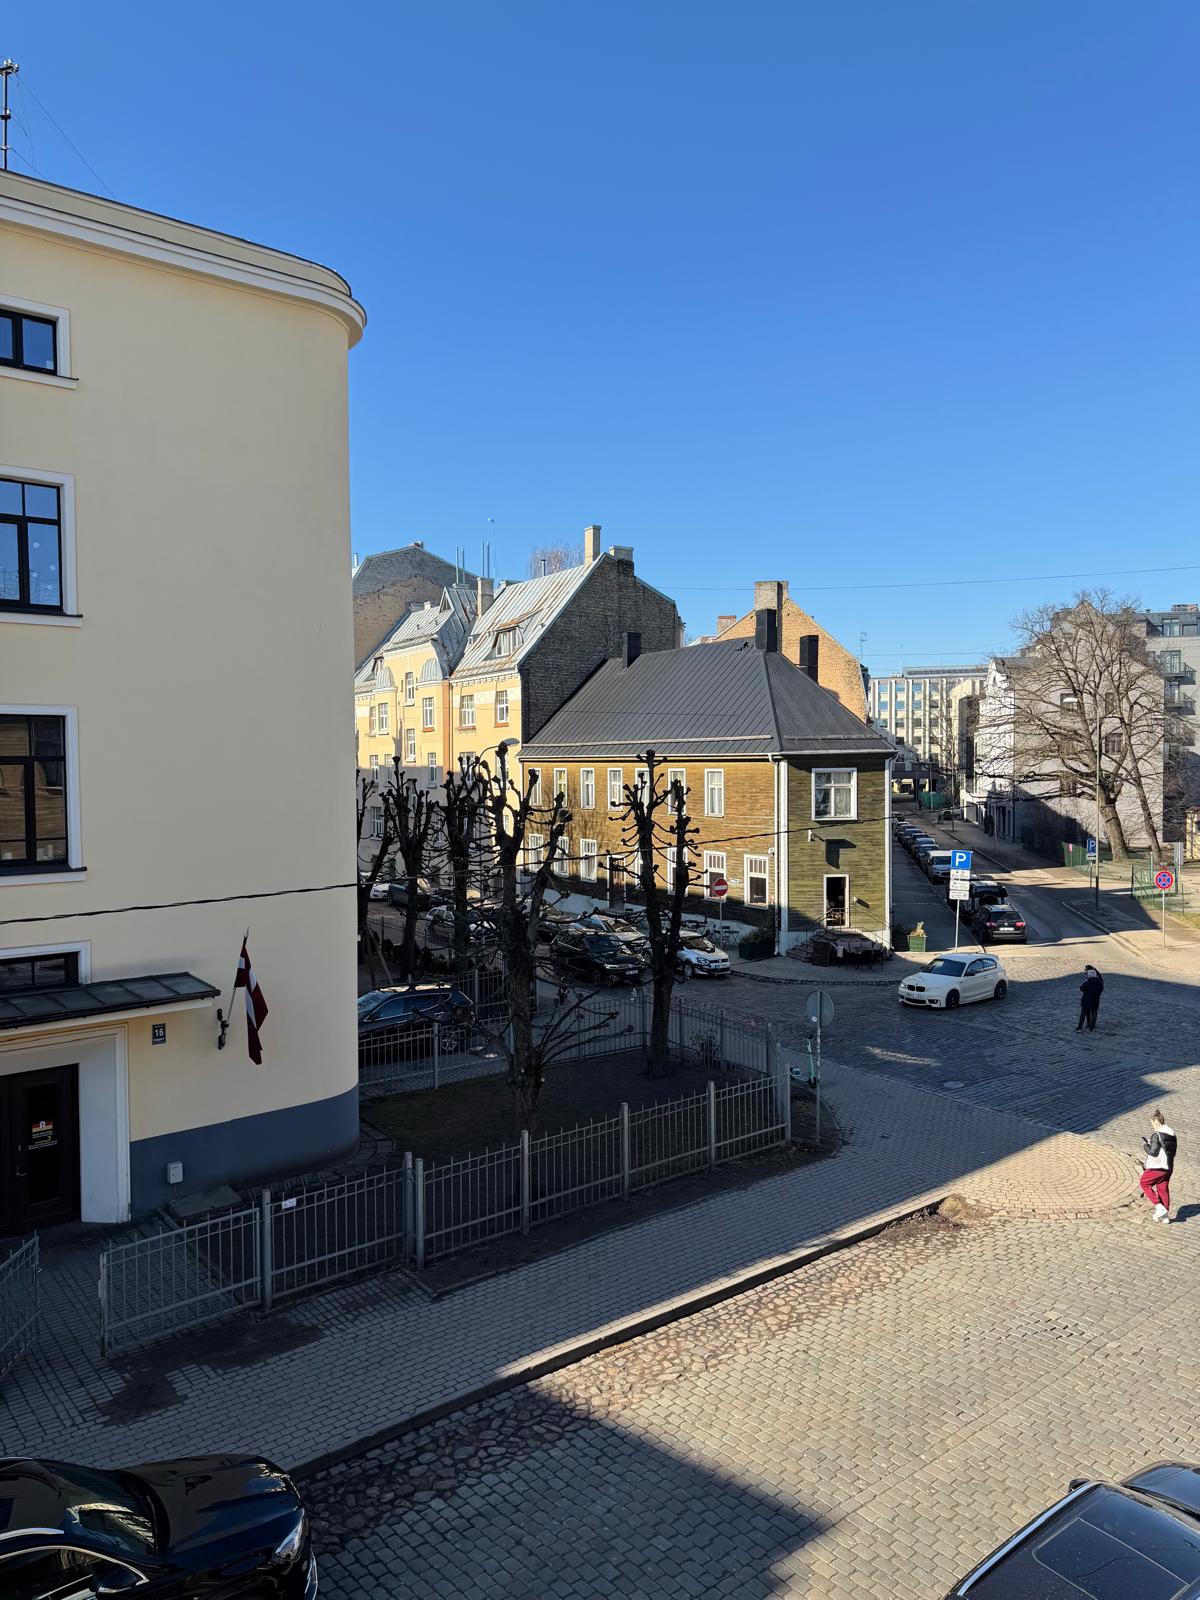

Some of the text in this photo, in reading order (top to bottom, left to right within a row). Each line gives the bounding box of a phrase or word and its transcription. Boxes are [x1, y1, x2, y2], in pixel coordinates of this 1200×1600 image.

[1090, 840, 1096, 851] P
[956, 853, 966, 866] P
[154, 1028, 164, 1037] 16
